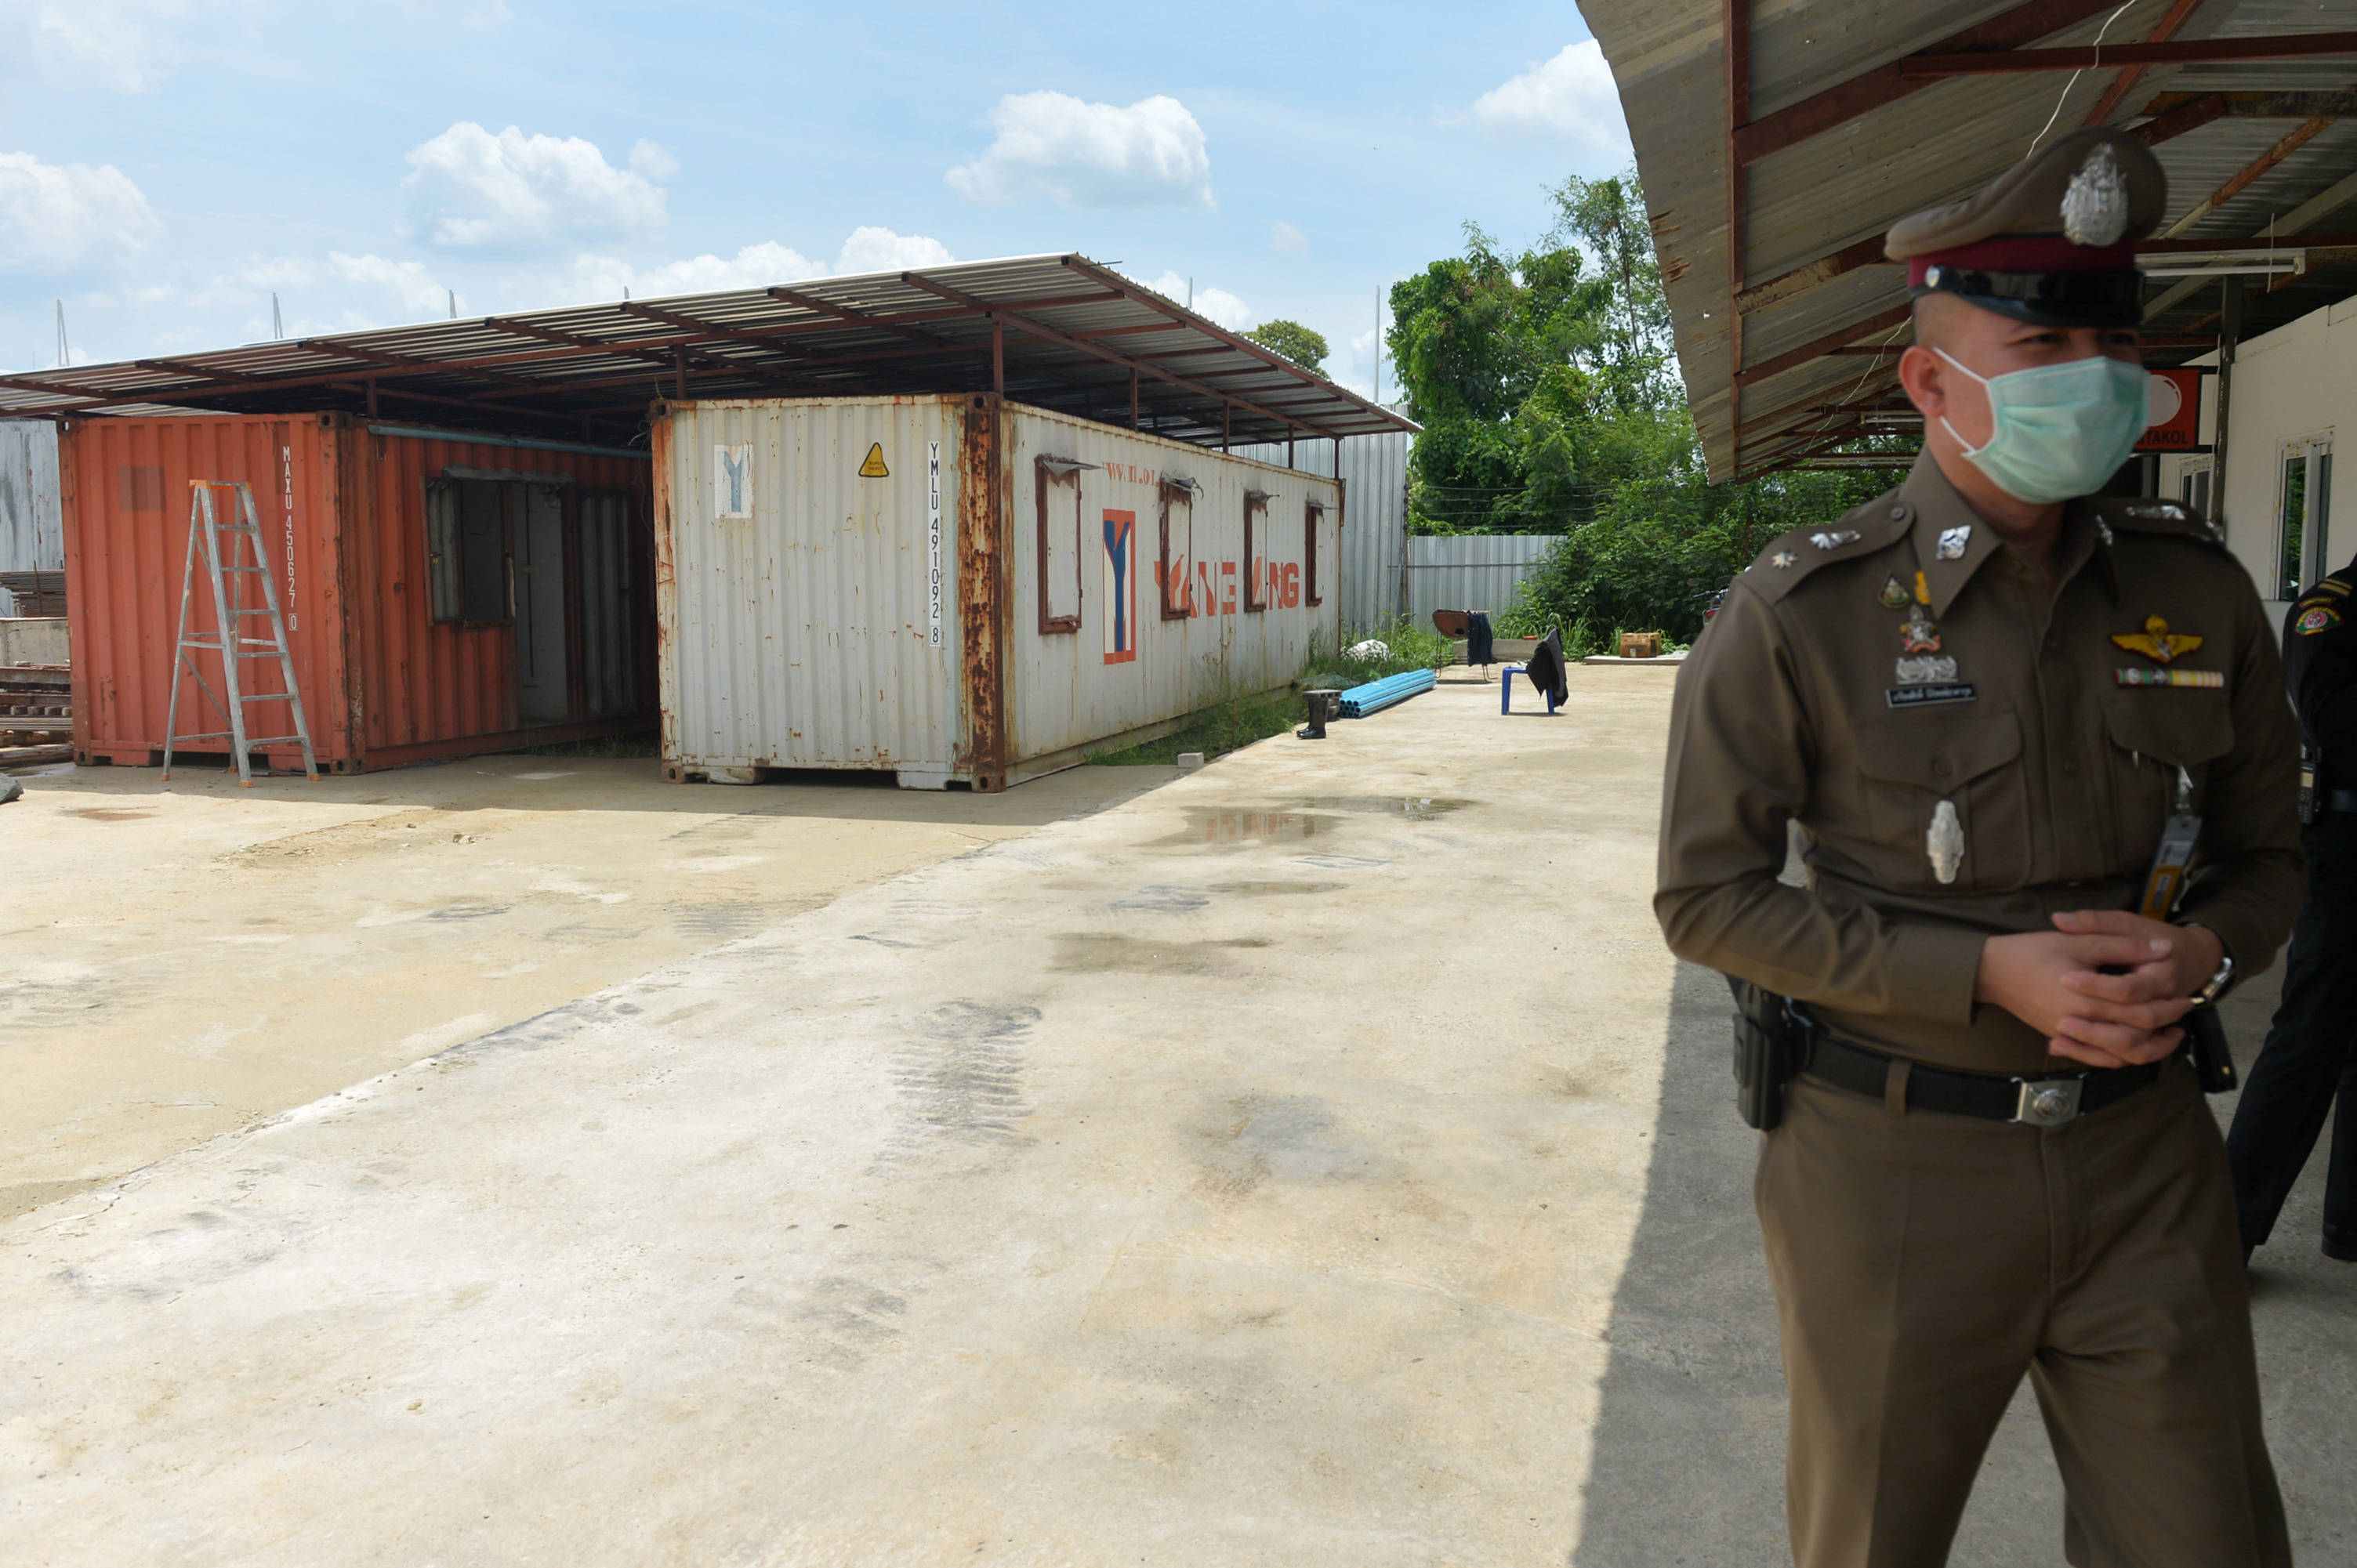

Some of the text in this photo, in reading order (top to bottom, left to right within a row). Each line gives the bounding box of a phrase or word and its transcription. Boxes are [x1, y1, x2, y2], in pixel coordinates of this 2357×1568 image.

[930, 443, 939, 509] YMLU
[283, 446, 297, 630] MAXU 450627 0
[932, 628, 939, 643] 8
